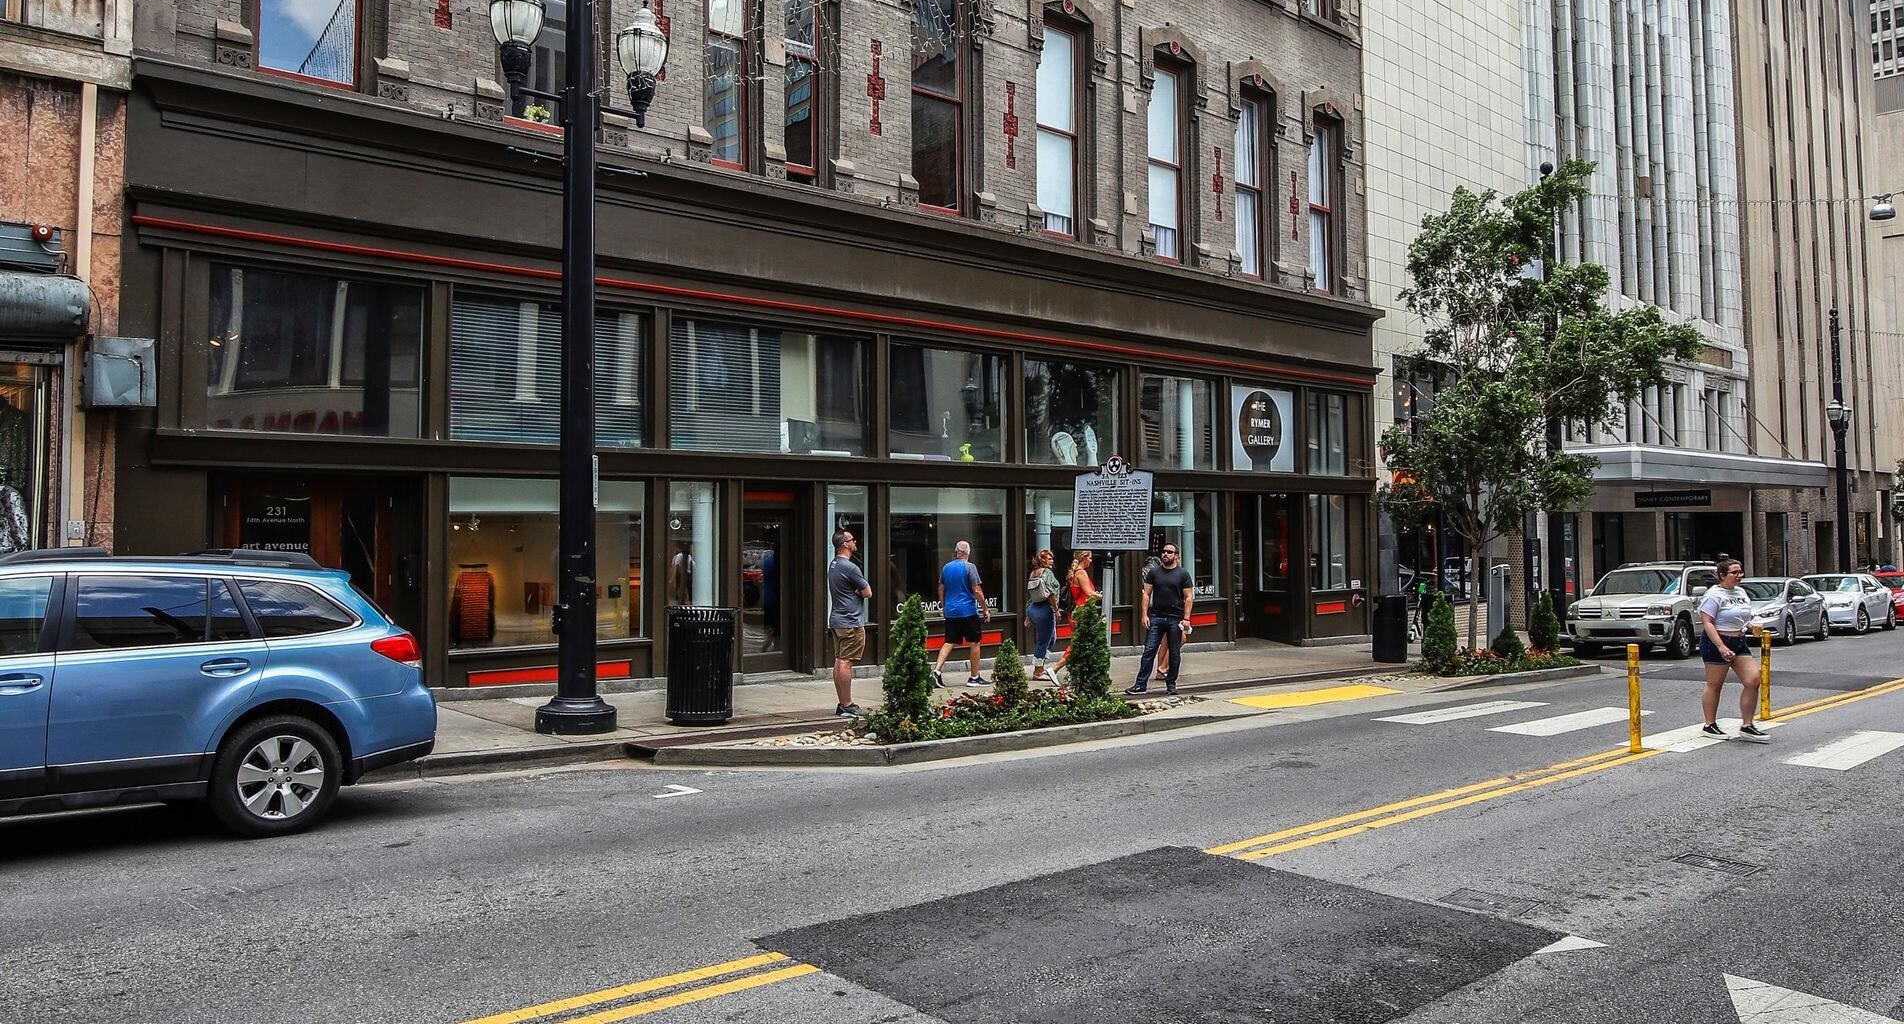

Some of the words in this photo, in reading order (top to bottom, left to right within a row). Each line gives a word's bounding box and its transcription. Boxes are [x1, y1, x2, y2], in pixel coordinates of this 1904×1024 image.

[1255, 401, 1266, 412] THE
[1250, 418, 1271, 429] RYMER
[1247, 434, 1275, 446] GALLERY
[1119, 478, 1142, 486] SIT-INS
[1659, 495, 1709, 503] CONTEMPORARY
[266, 506, 287, 516] 231
[242, 542, 260, 550] art
[264, 542, 309, 550] avenue
[1204, 585, 1215, 594] ART
[984, 597, 998, 607] ART
